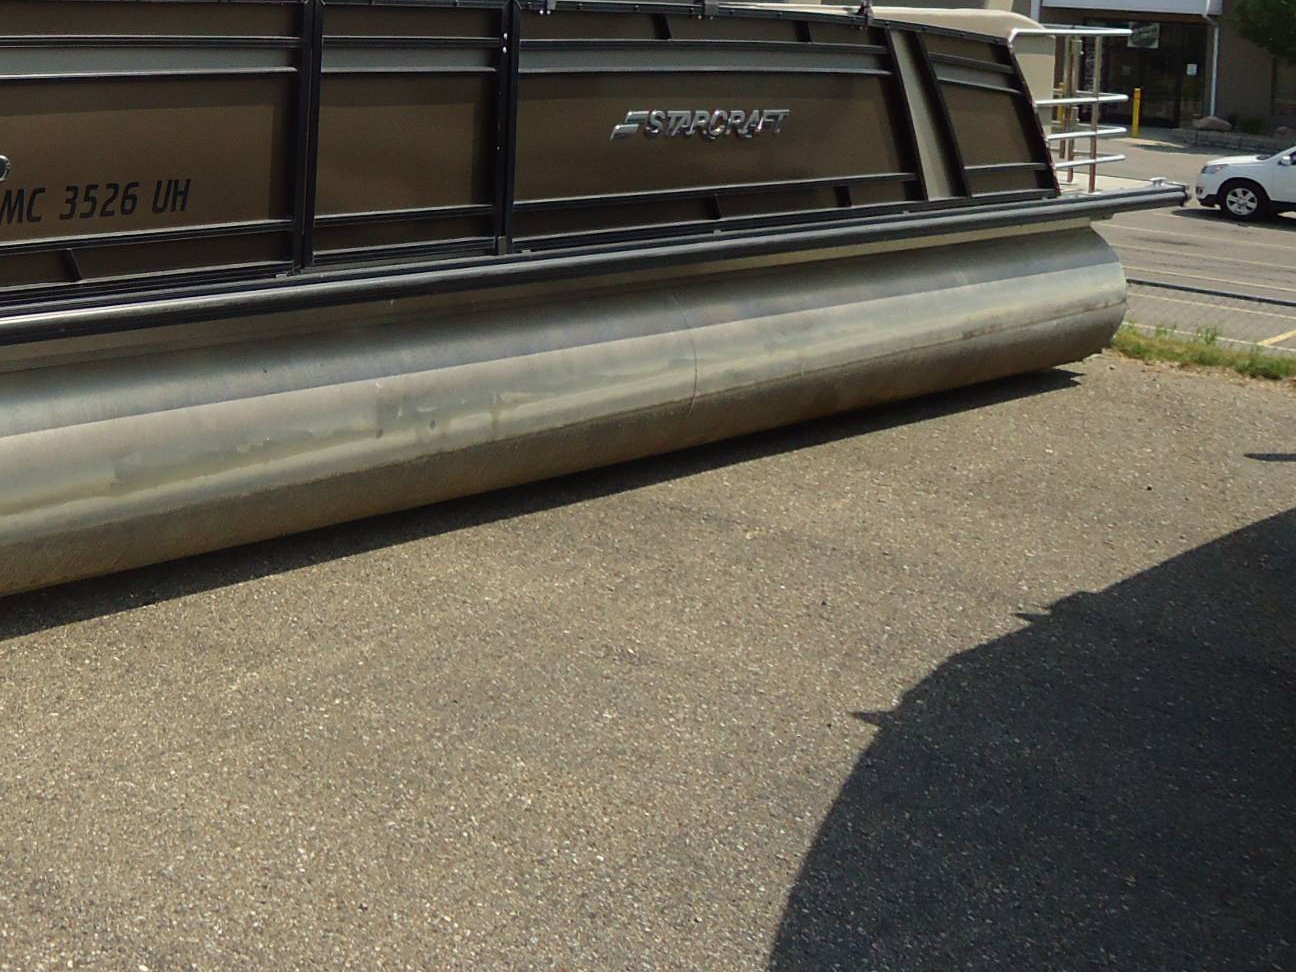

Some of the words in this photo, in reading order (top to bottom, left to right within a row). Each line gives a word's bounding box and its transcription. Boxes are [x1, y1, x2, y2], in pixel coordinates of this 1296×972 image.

[645, 109, 790, 139] STARCRAFT
[59, 182, 140, 220] 3526
[151, 179, 191, 213] UH
